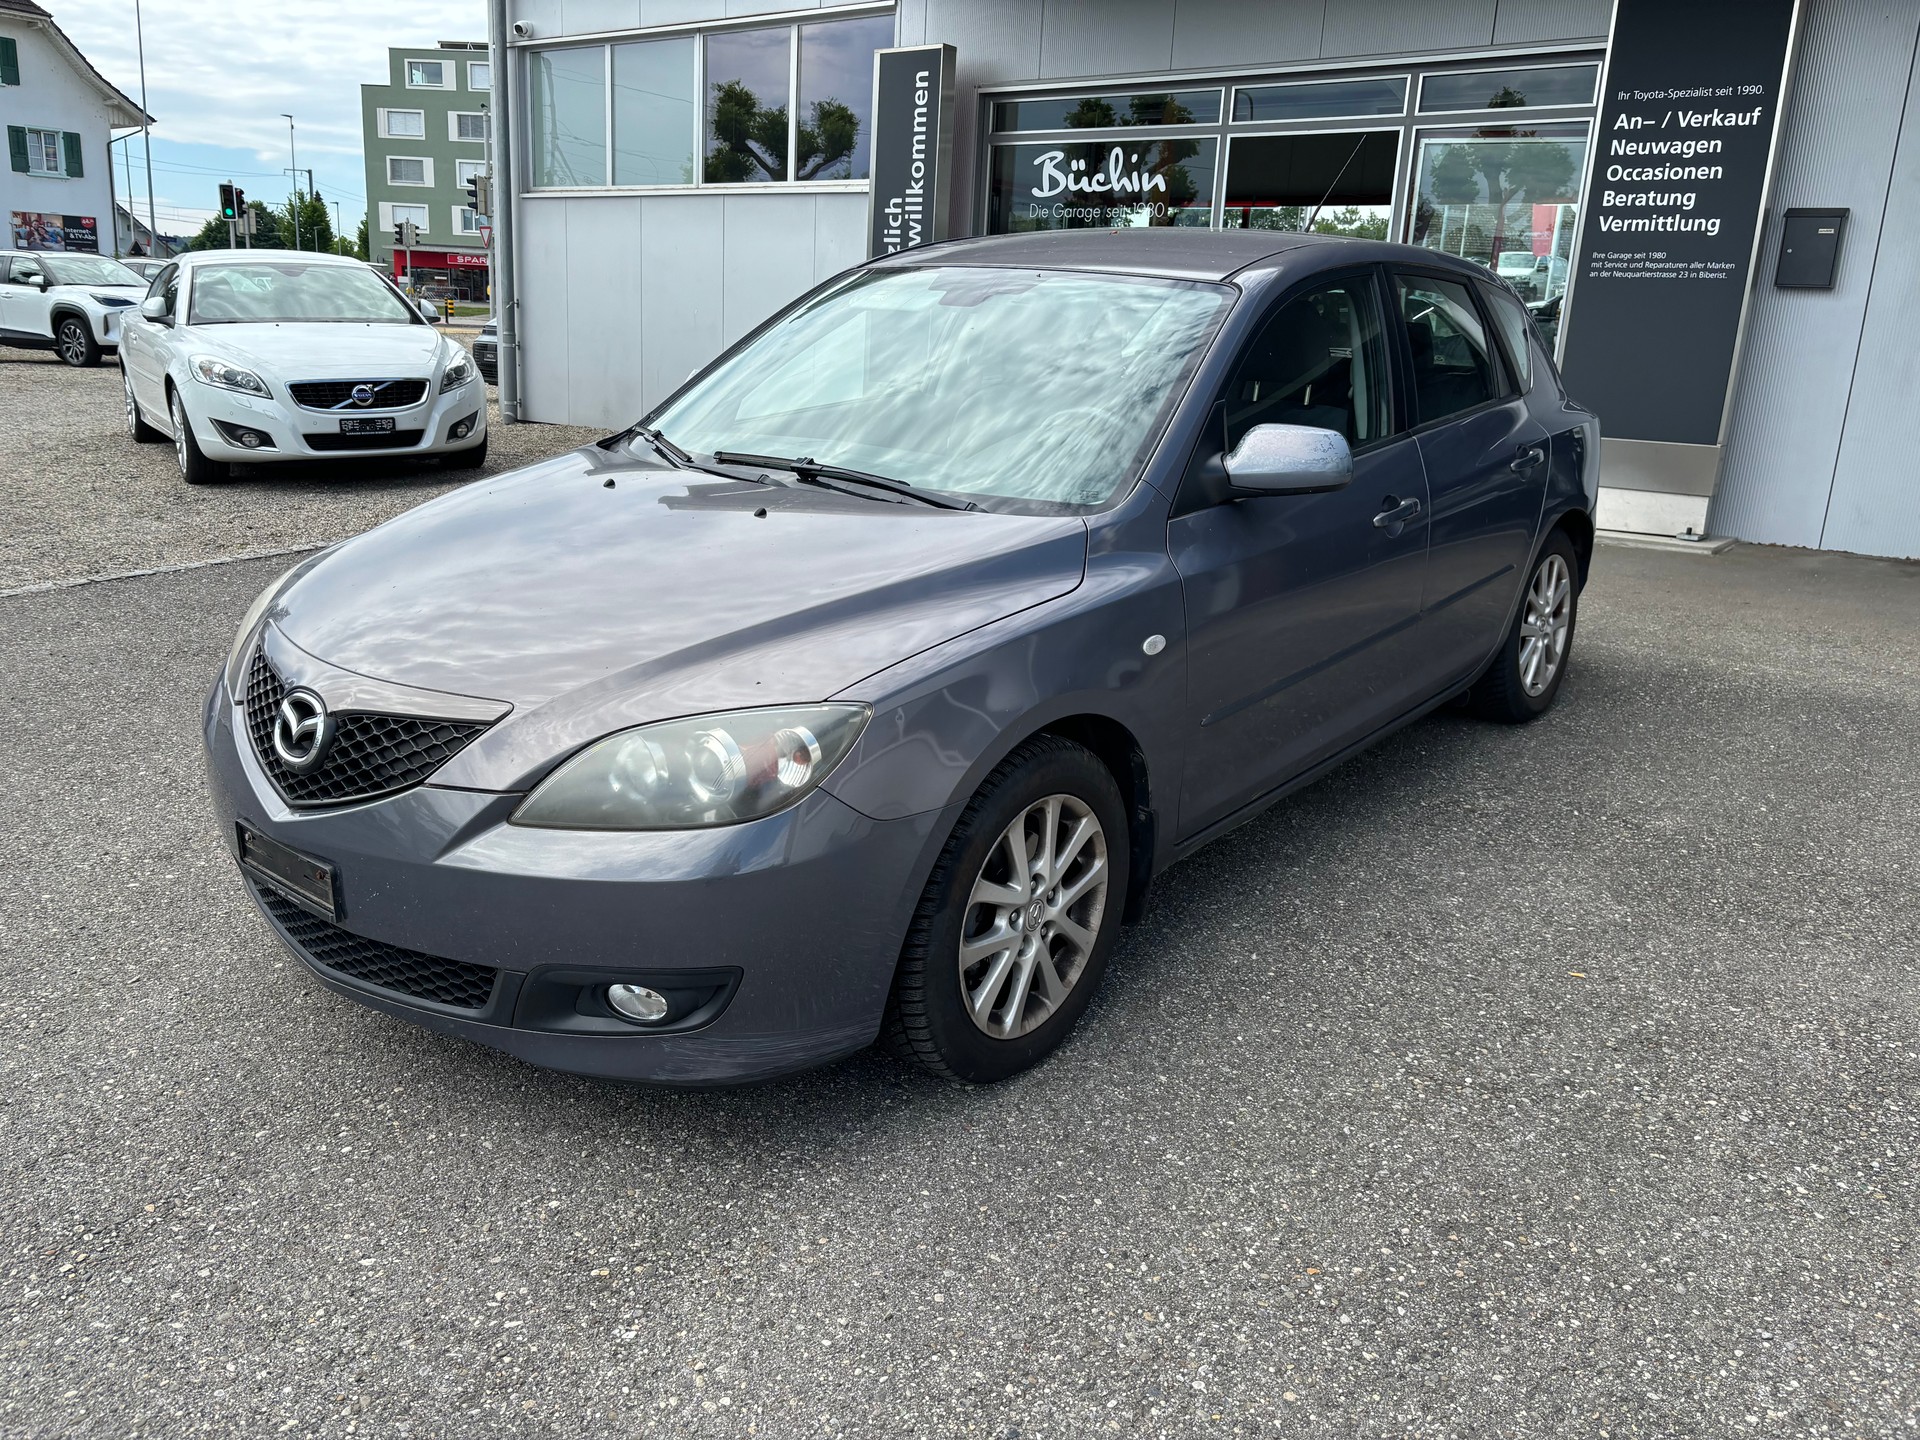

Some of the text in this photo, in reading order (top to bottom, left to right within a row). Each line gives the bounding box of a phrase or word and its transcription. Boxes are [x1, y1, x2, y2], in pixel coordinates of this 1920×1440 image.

[1618, 84, 1765, 102] Ihr Toyota-Spezialist seit 1990.
[1661, 111, 1672, 129] /
[1677, 106, 1763, 128] Verkauf
[1610, 139, 1722, 158] Neuwagen
[904, 70, 929, 247] willkommen
[1031, 146, 1167, 198] Büchin
[1606, 162, 1723, 181] Occasionen
[1602, 190, 1696, 210] Beratung
[1029, 203, 1049, 218] Die
[1052, 203, 1101, 223] Garage
[1105, 204, 1127, 218] seit
[1599, 213, 1721, 236] Vermittlung
[456, 255, 487, 264] SPAR
[1607, 252, 1632, 261] Garage
[1644, 262, 1688, 270] Reparaturen
[1706, 262, 1736, 270] Marken
[1599, 270, 1612, 278] der
[1612, 271, 1677, 279] Neuquartierstrasse
[1698, 271, 1728, 279] Biberist.
